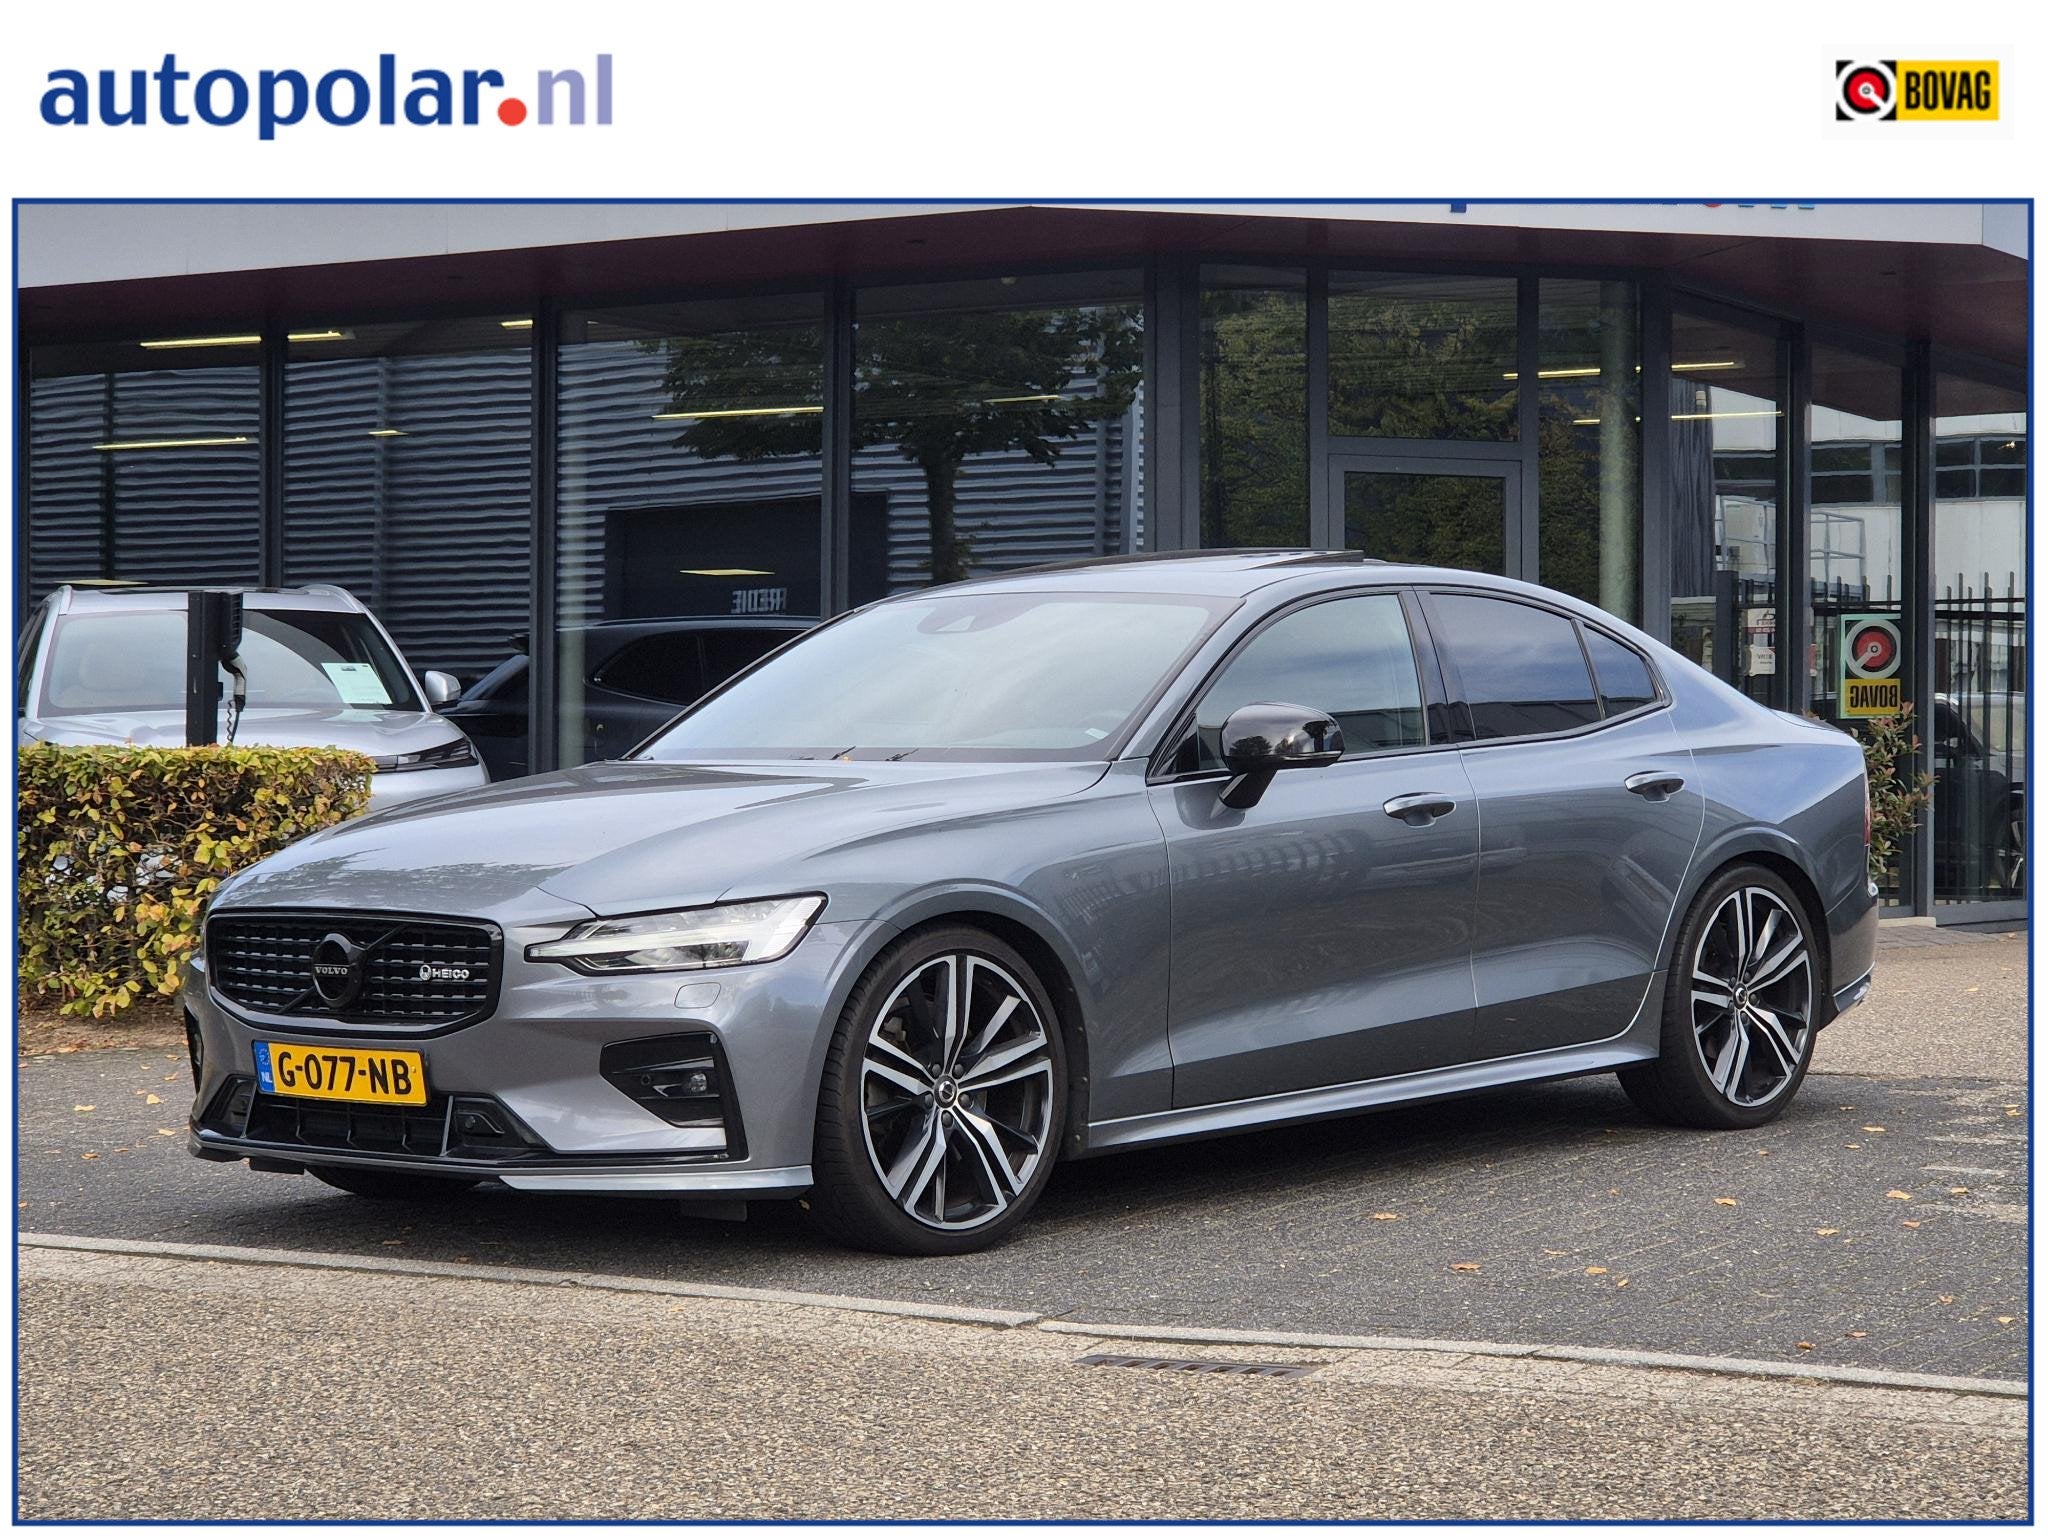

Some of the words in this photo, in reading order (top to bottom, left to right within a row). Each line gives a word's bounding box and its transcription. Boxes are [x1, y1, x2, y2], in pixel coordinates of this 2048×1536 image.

[315, 966, 348, 975] VOLVO
[432, 967, 470, 979] HEICO
[278, 1051, 412, 1095] G-077-NB
